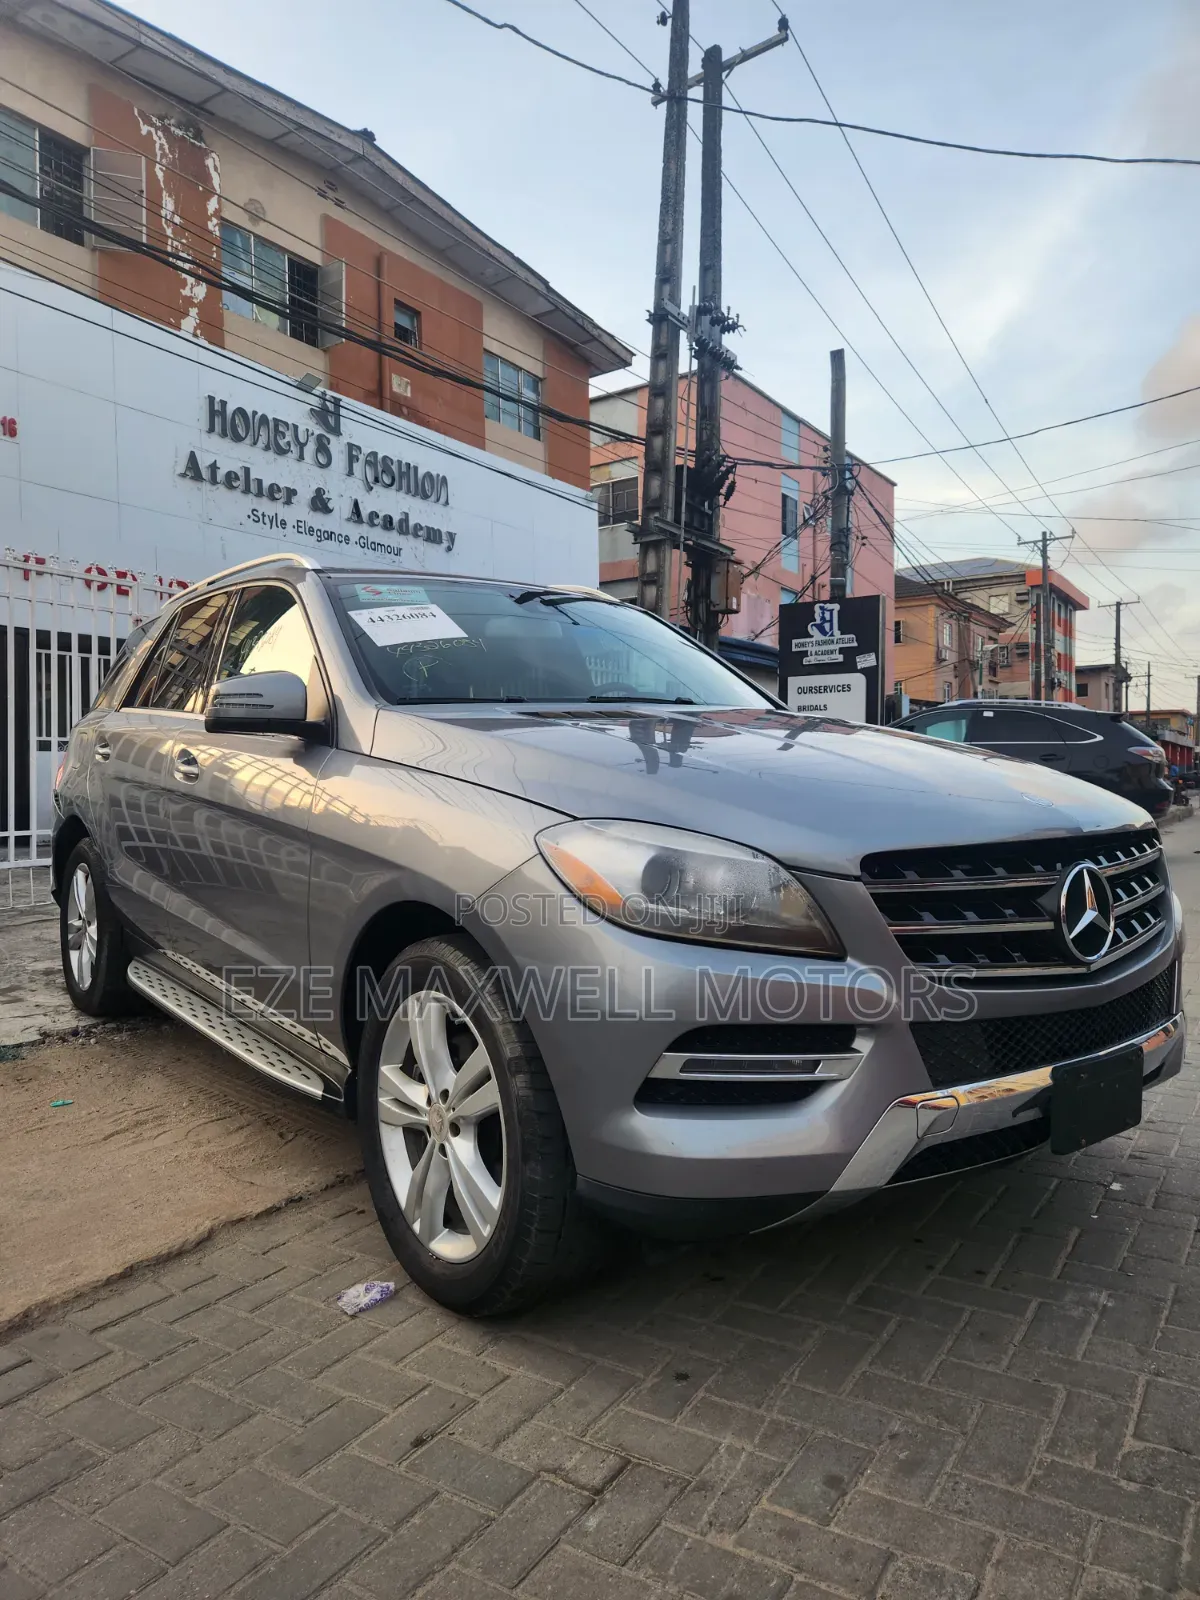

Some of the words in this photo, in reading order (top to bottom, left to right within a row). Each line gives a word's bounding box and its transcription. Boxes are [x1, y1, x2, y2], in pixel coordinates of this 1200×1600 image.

[346, 441, 450, 506] FASHION
[310, 487, 334, 514] &
[345, 498, 457, 552] Academy
[815, 638, 835, 648] FASHION
[814, 648, 838, 657] ACADEMY
[797, 684, 852, 694] OURSERVICES
[797, 703, 828, 712] BRIDALS
